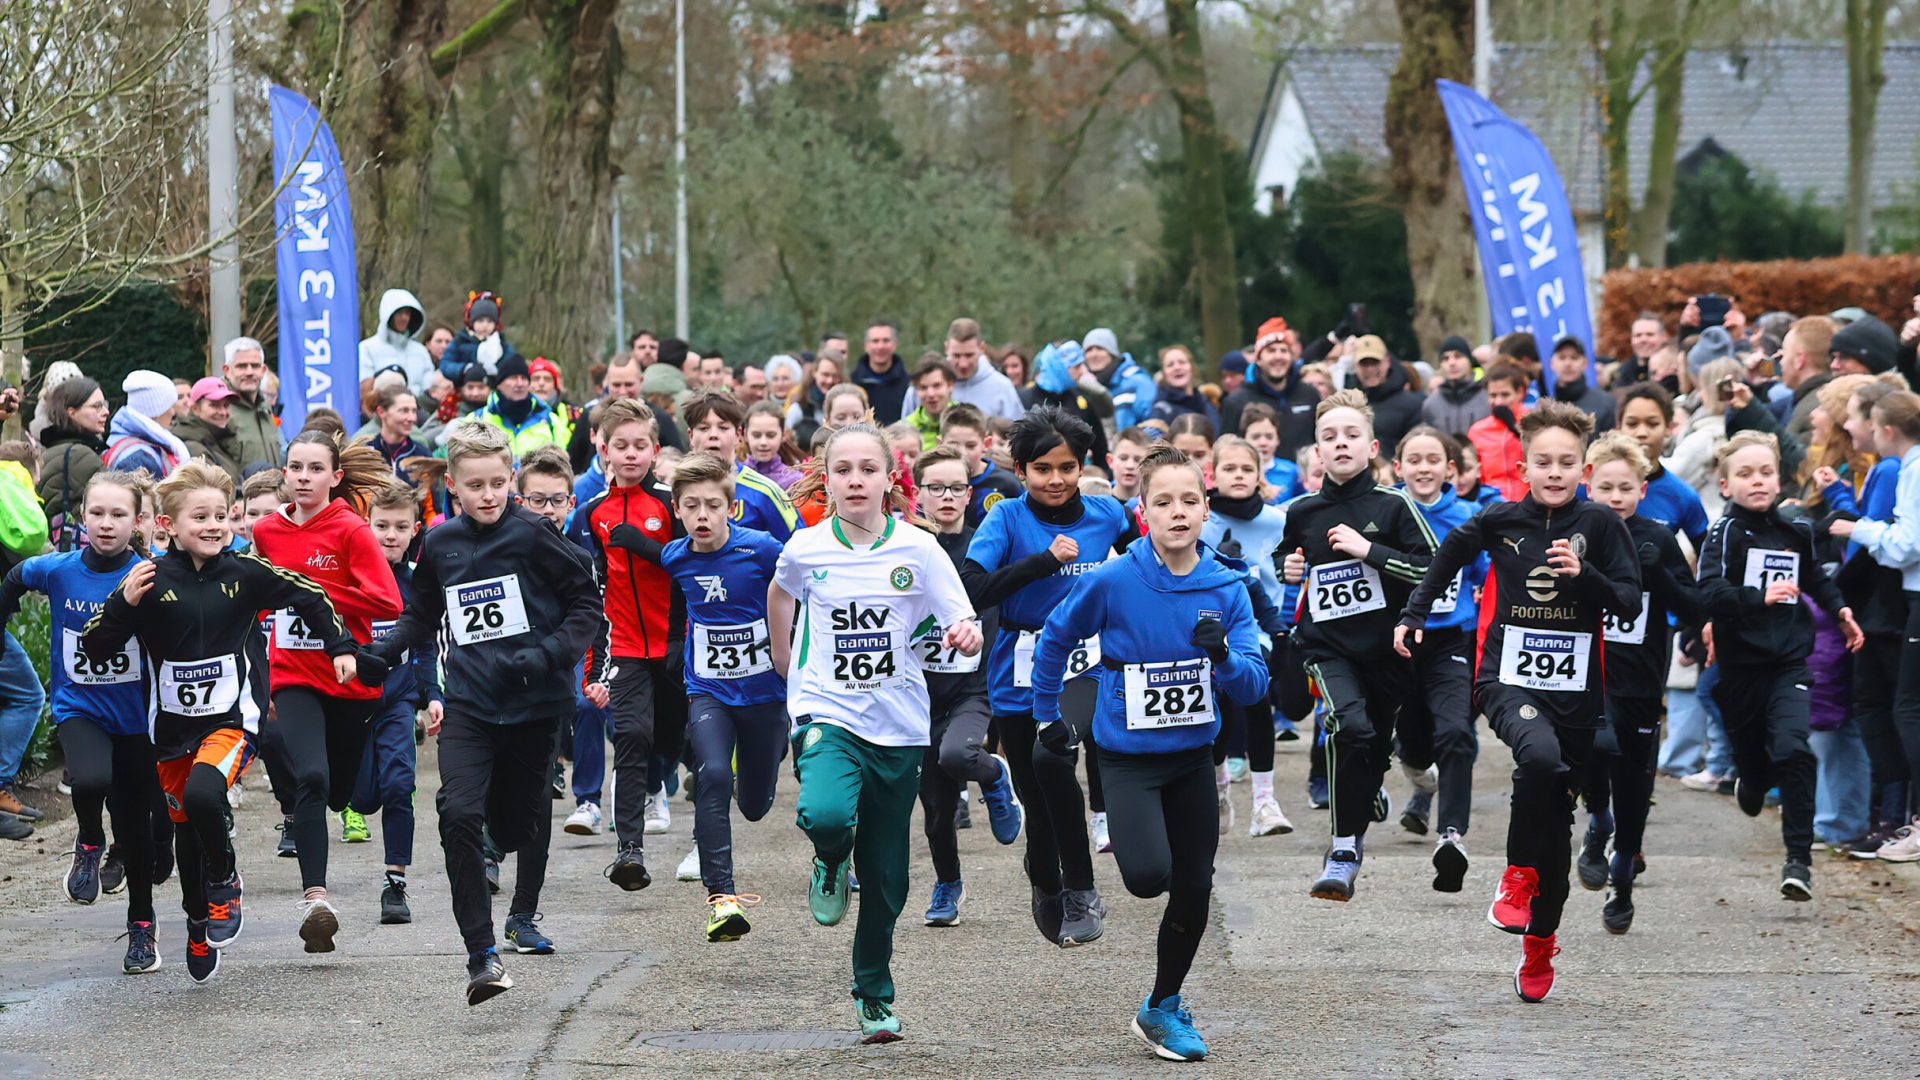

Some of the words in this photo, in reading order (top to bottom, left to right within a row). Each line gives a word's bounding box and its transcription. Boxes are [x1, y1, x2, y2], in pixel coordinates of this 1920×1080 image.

[1317, 579, 1372, 610] 266
[64, 598, 86, 612] A.V.
[1341, 606, 1362, 615] Weert
[463, 602, 504, 633] 26
[1511, 605, 1577, 620] FOOTBALL
[470, 633, 480, 641] AV
[481, 629, 504, 638] Weert
[292, 640, 303, 648] AV
[303, 640, 322, 648] Weert
[707, 643, 758, 670] 231
[833, 651, 896, 681] 264
[1516, 650, 1577, 680] 294
[716, 669, 727, 677] AV
[728, 668, 749, 677] Weert
[858, 681, 881, 689] Weert
[1526, 679, 1537, 687] AV
[1538, 680, 1561, 688] Weert
[177, 680, 217, 707] 67
[1144, 684, 1206, 717] 282
[193, 706, 216, 714] Weert
[1169, 716, 1194, 724] Weert
